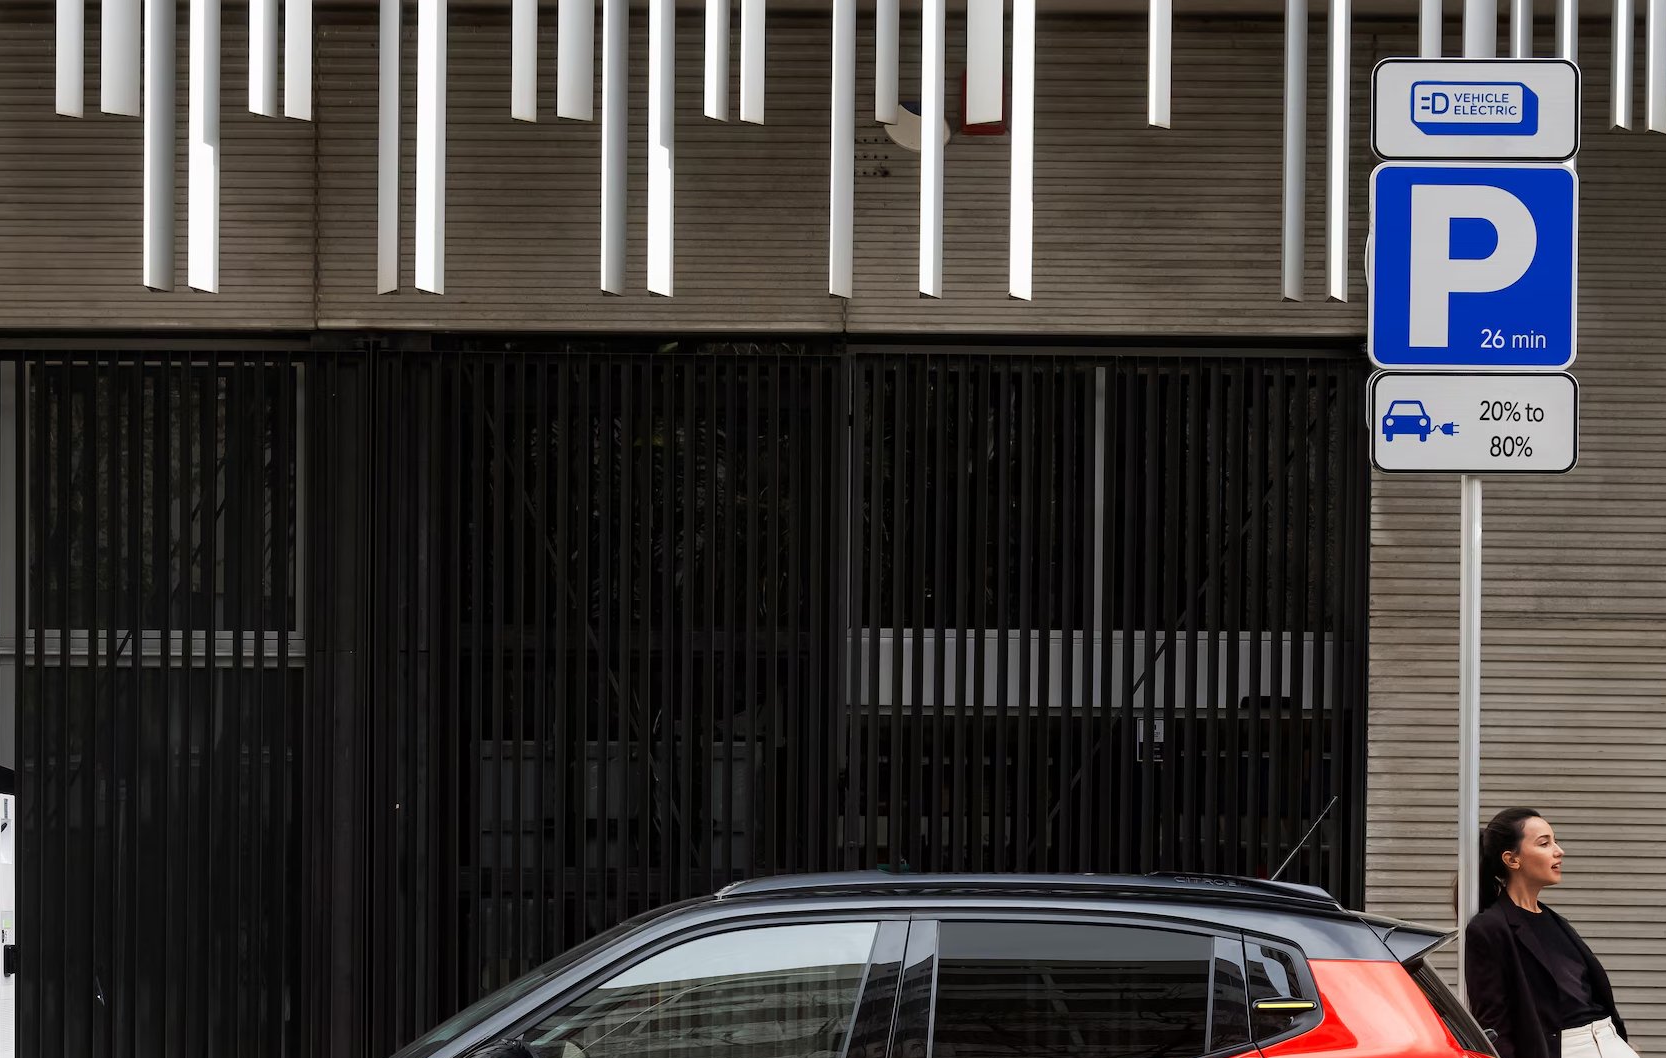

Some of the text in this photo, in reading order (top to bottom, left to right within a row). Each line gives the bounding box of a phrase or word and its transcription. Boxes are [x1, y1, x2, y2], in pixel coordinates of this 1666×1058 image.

[1454, 93, 1509, 103] VEHICLE
[1454, 103, 1517, 115] ELÈCTRIC
[1409, 184, 1537, 347] P
[1480, 328, 1547, 349] 26 min
[1479, 400, 1545, 422] 20% to
[1489, 435, 1533, 457] 80%
